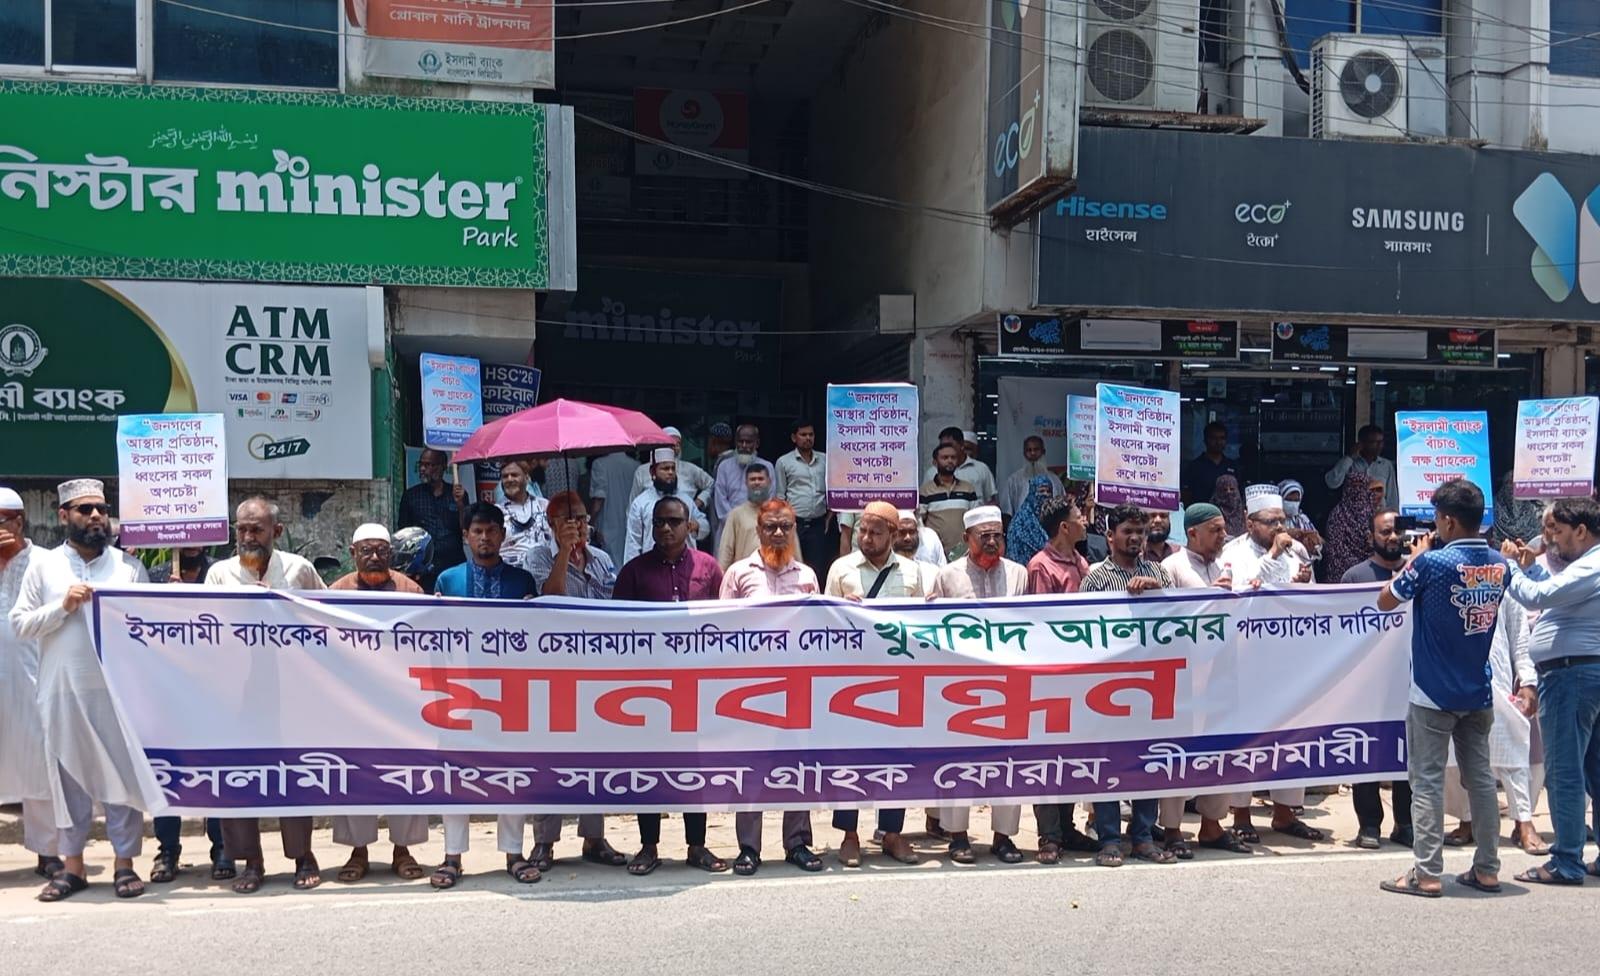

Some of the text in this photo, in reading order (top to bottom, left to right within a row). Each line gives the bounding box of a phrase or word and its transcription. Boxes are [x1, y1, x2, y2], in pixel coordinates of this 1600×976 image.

[443, 13, 474, 26] মানি
[444, 52, 504, 71] ইসলামী ব্যাংক
[0, 144, 198, 214] নিস্টার
[217, 150, 518, 221] minister
[1056, 196, 1168, 220] Hisense
[1351, 207, 1465, 232] SAMSUNG
[463, 226, 519, 249] Park
[226, 305, 331, 340] ATM
[562, 298, 761, 349] minister
[225, 343, 331, 377] CRM
[485, 367, 533, 385] HSC'26
[0, 381, 126, 411] মী ব্যাংক
[229, 393, 248, 401] VISA
[482, 382, 535, 403] ফাইনাল
[833, 409, 864, 421] আস্থার
[1104, 405, 1133, 420] আস্থার
[836, 422, 908, 436] ইসলামী ব্যাংক
[1107, 419, 1143, 435] ইসলামী
[1146, 425, 1172, 439] ব্যাংক
[1452, 419, 1483, 434] ব্যাংক
[126, 438, 164, 451] আস্থার
[268, 442, 302, 457] 24/7
[840, 441, 906, 452] ধ্বংসের সকল
[1110, 438, 1170, 453] ধ্বংসের সকল
[131, 450, 215, 466] ইসলামী ব্যাংক
[852, 455, 893, 467] অপচেষ্টা
[1121, 452, 1158, 467] অপচেষ্টা
[1411, 454, 1477, 468] লক্ষ গ্রাহকের
[135, 469, 212, 482] ধ্বংসের সকল
[847, 472, 870, 483] রুখে
[1116, 468, 1137, 481] রুখে
[150, 484, 198, 498] অপচেষ্টা
[143, 503, 171, 516] রুখে
[125, 605, 1407, 660] ইসলামী ব্যাংকের সদ্য নিয়োগ প্রাপ্ত চেয়ারম্যান ফ্যাসিবাদের দোসর খুরশিদ আলমের পদত্যাগের দাবিতে
[408, 657, 1187, 740] মানববন্ধন
[149, 751, 359, 800] ইসলামী
[371, 760, 538, 797] ব্যাংক
[549, 764, 754, 798] সচেতন
[764, 761, 916, 796] গ্রাহক
[933, 755, 1121, 791] ফোরাম,
[1137, 727, 1380, 781] নীলফামারী
